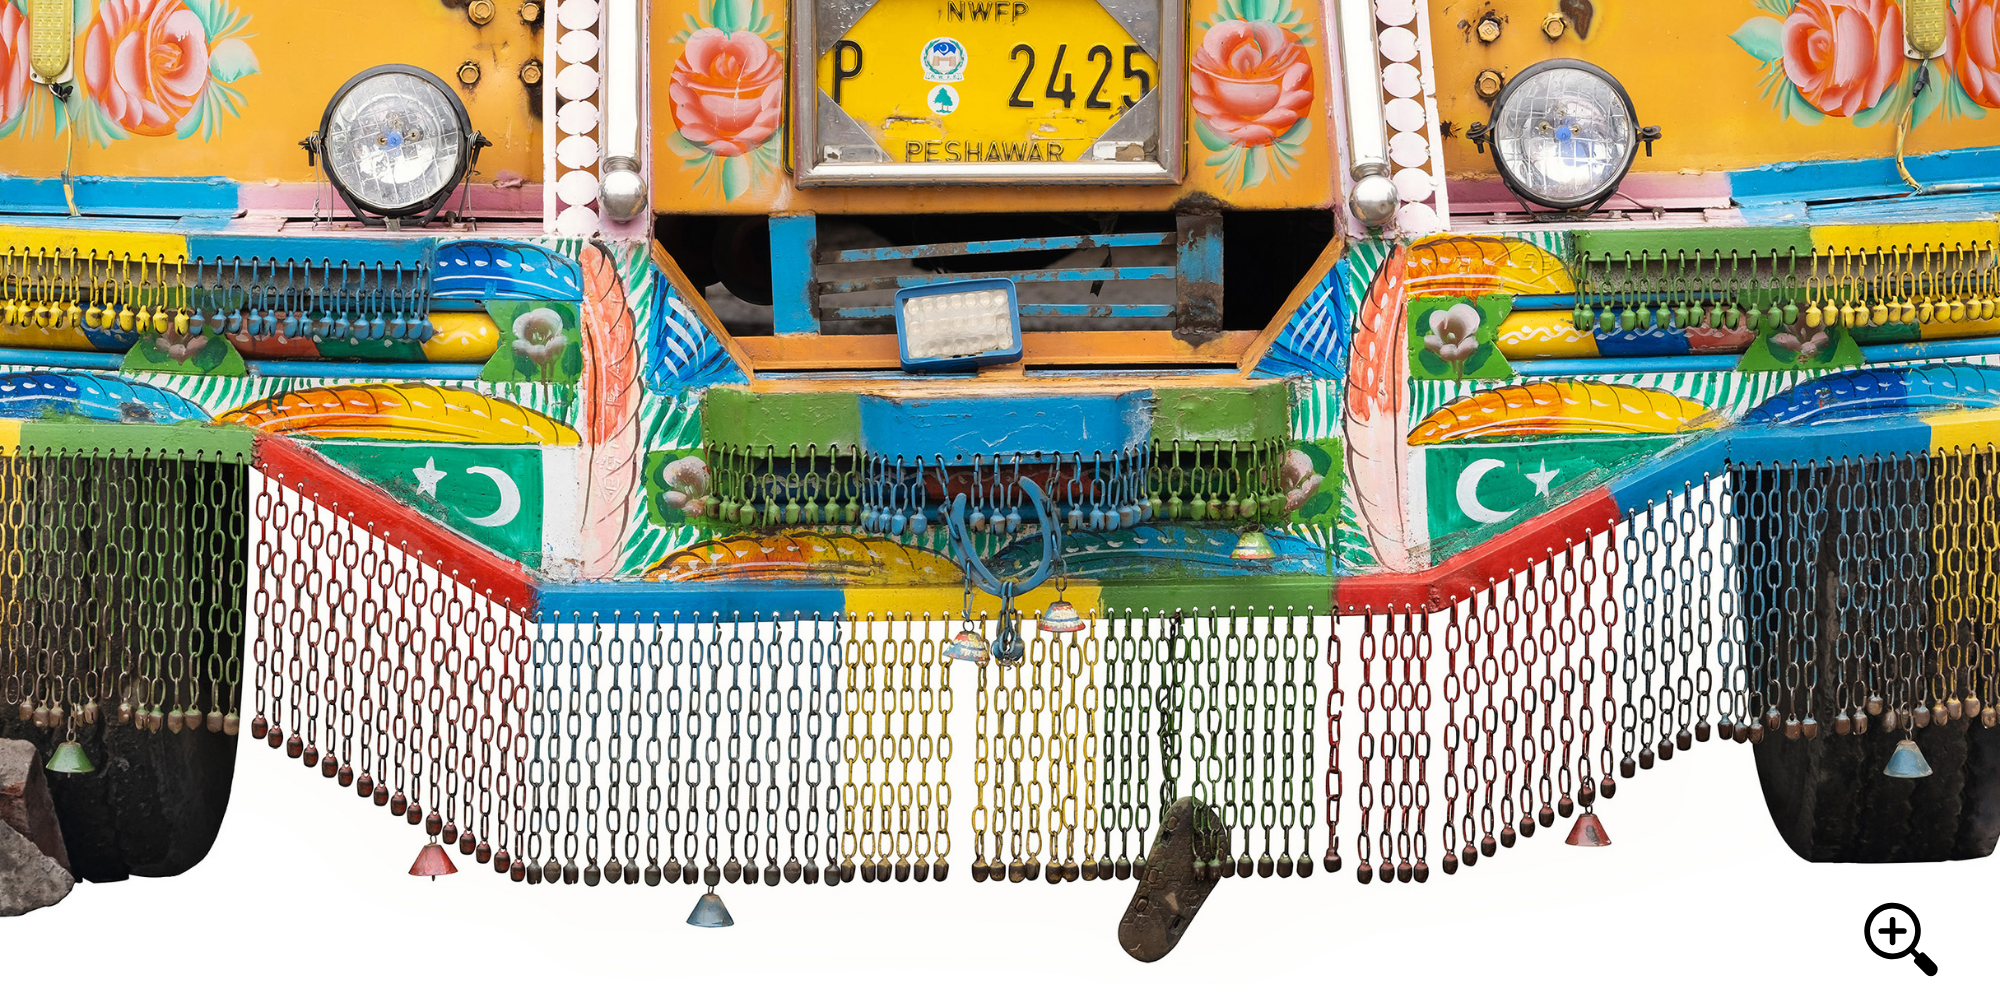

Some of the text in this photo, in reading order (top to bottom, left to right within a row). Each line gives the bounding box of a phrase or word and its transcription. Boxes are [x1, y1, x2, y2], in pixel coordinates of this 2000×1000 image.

[947, 2, 1028, 23] NWFP
[833, 40, 1149, 109] P 2425
[905, 140, 1065, 162] PESHAWAR
